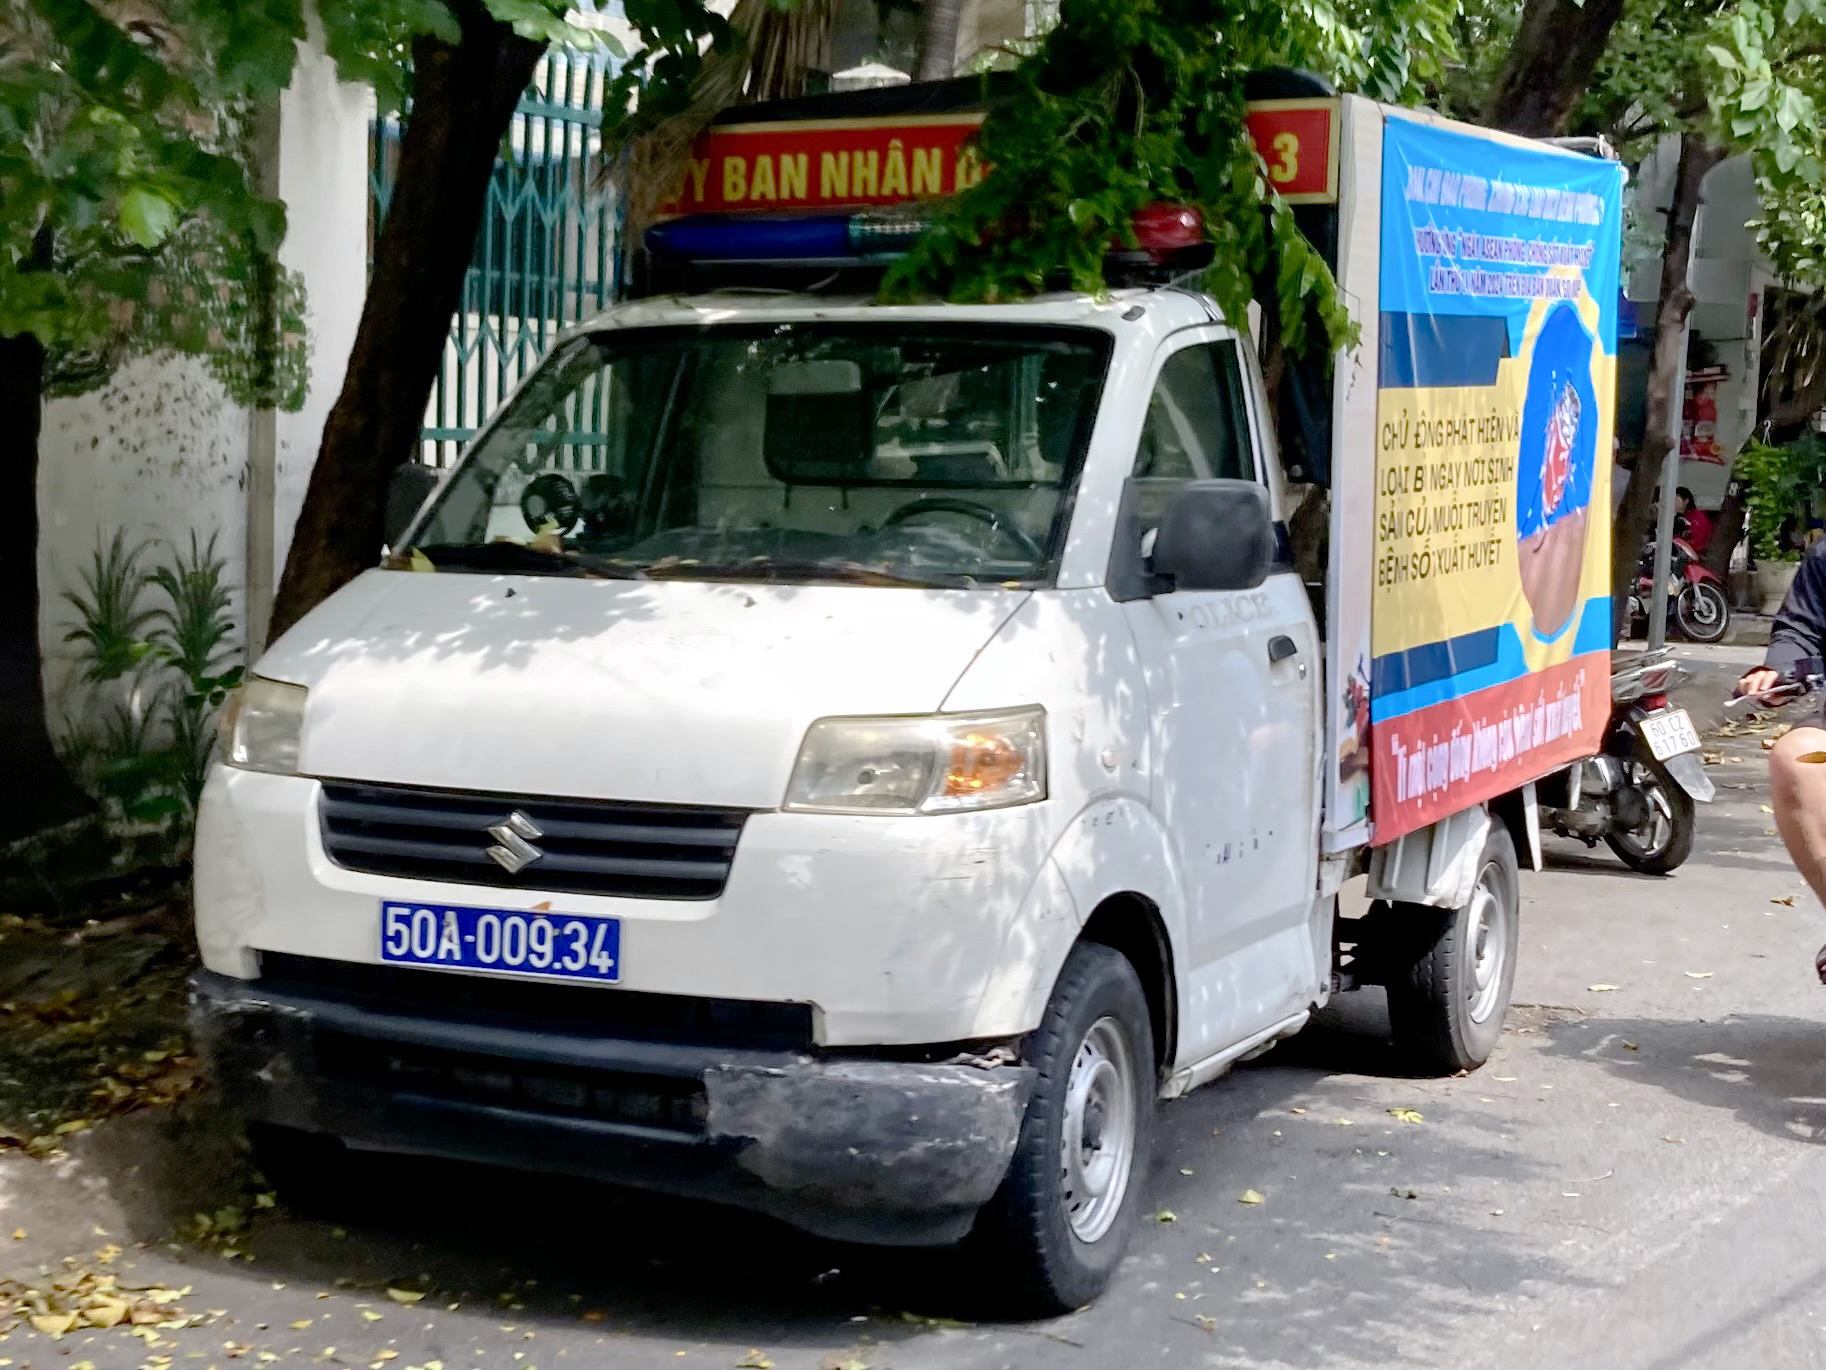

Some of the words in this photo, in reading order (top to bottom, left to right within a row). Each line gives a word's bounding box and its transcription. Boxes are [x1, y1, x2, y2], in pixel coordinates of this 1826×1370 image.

[722, 152, 809, 202] BAN
[820, 138, 943, 199] NHÂN
[1271, 131, 1299, 183] 3
[1383, 408, 1409, 451] CHỦ
[1414, 410, 1444, 457] ĐỘNG
[1446, 413, 1475, 447] PHÁT
[1478, 407, 1504, 450] HIỆN
[1507, 410, 1519, 442] VÀ
[1430, 461, 1462, 491] NGAY
[1465, 457, 1485, 487] NƠI
[1487, 455, 1515, 484] SINH
[1379, 499, 1404, 542] SẢN
[1466, 485, 1508, 528] TRUYỀN
[1378, 546, 1409, 594] BỆNH
[1436, 532, 1466, 576] XUẤT
[1468, 526, 1502, 571] HUYẾT
[385, 906, 614, 975] 50A-009.34
